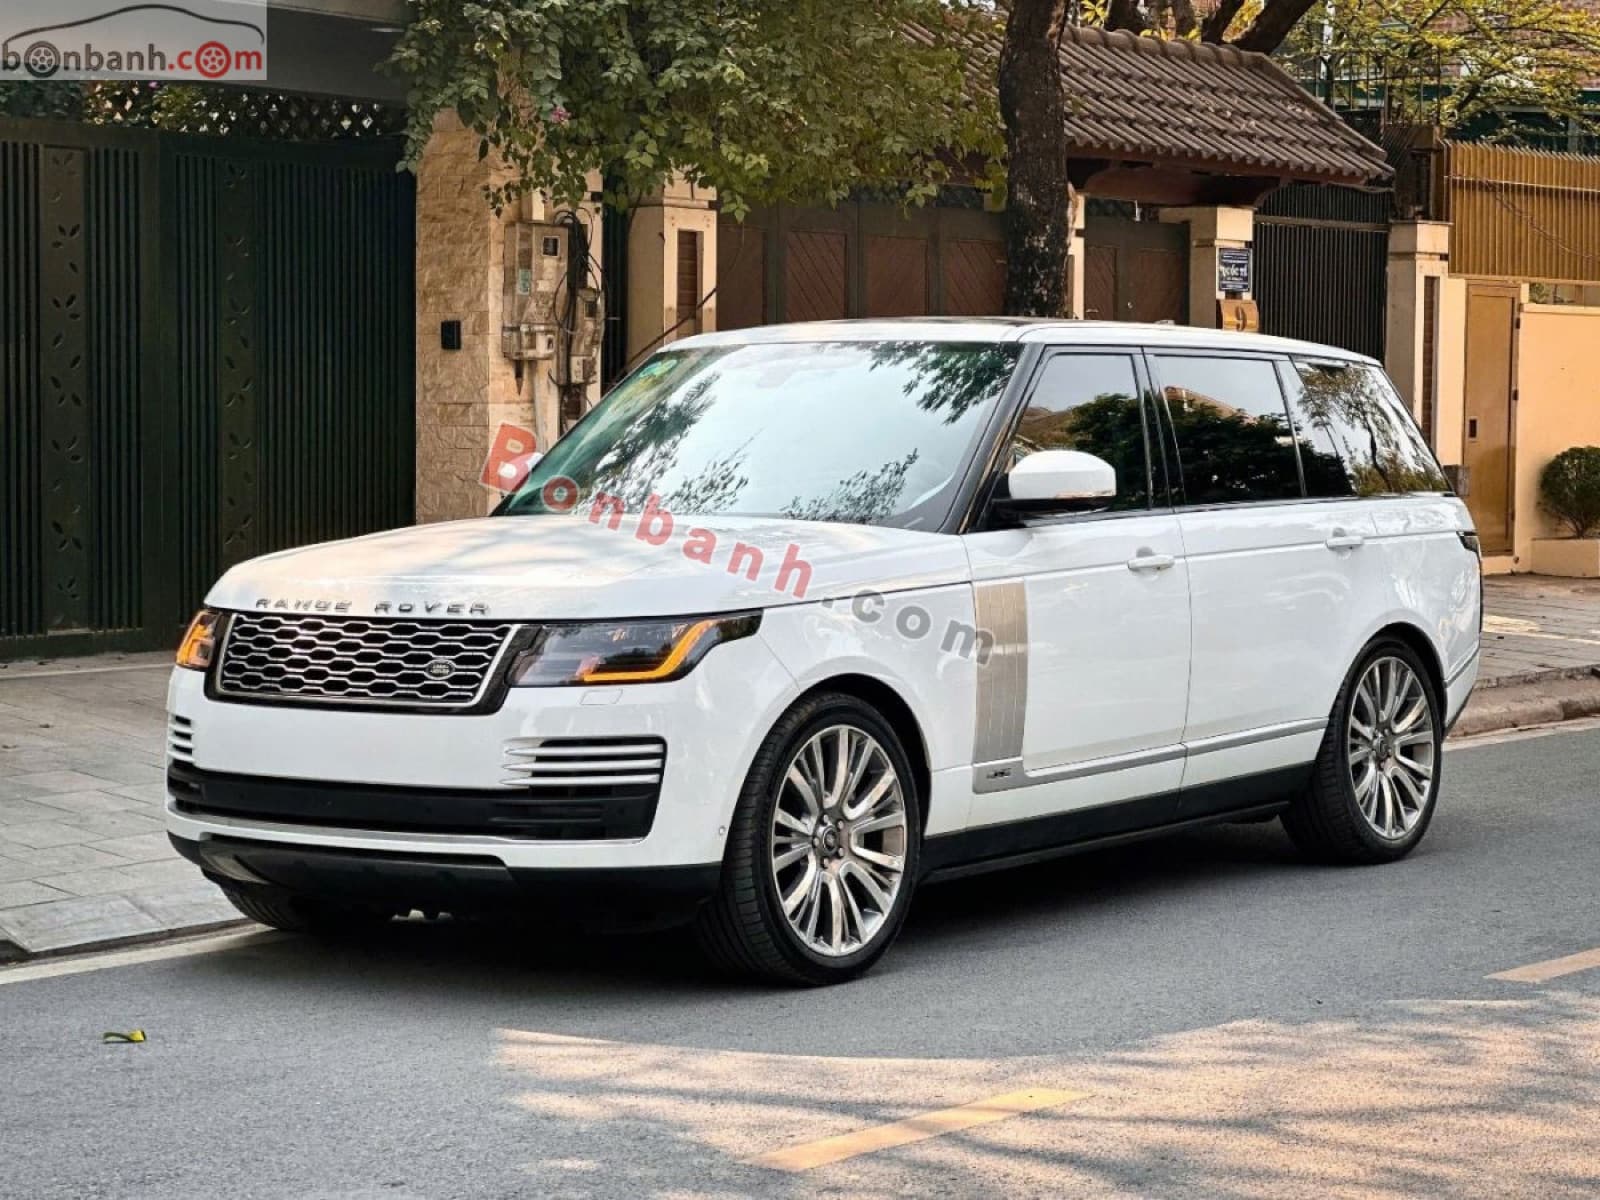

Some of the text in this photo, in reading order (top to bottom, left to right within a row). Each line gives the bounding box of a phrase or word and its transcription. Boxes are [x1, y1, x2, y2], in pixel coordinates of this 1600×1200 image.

[1235, 305, 1248, 332] 9
[255, 598, 490, 615] RANGE ROVER
